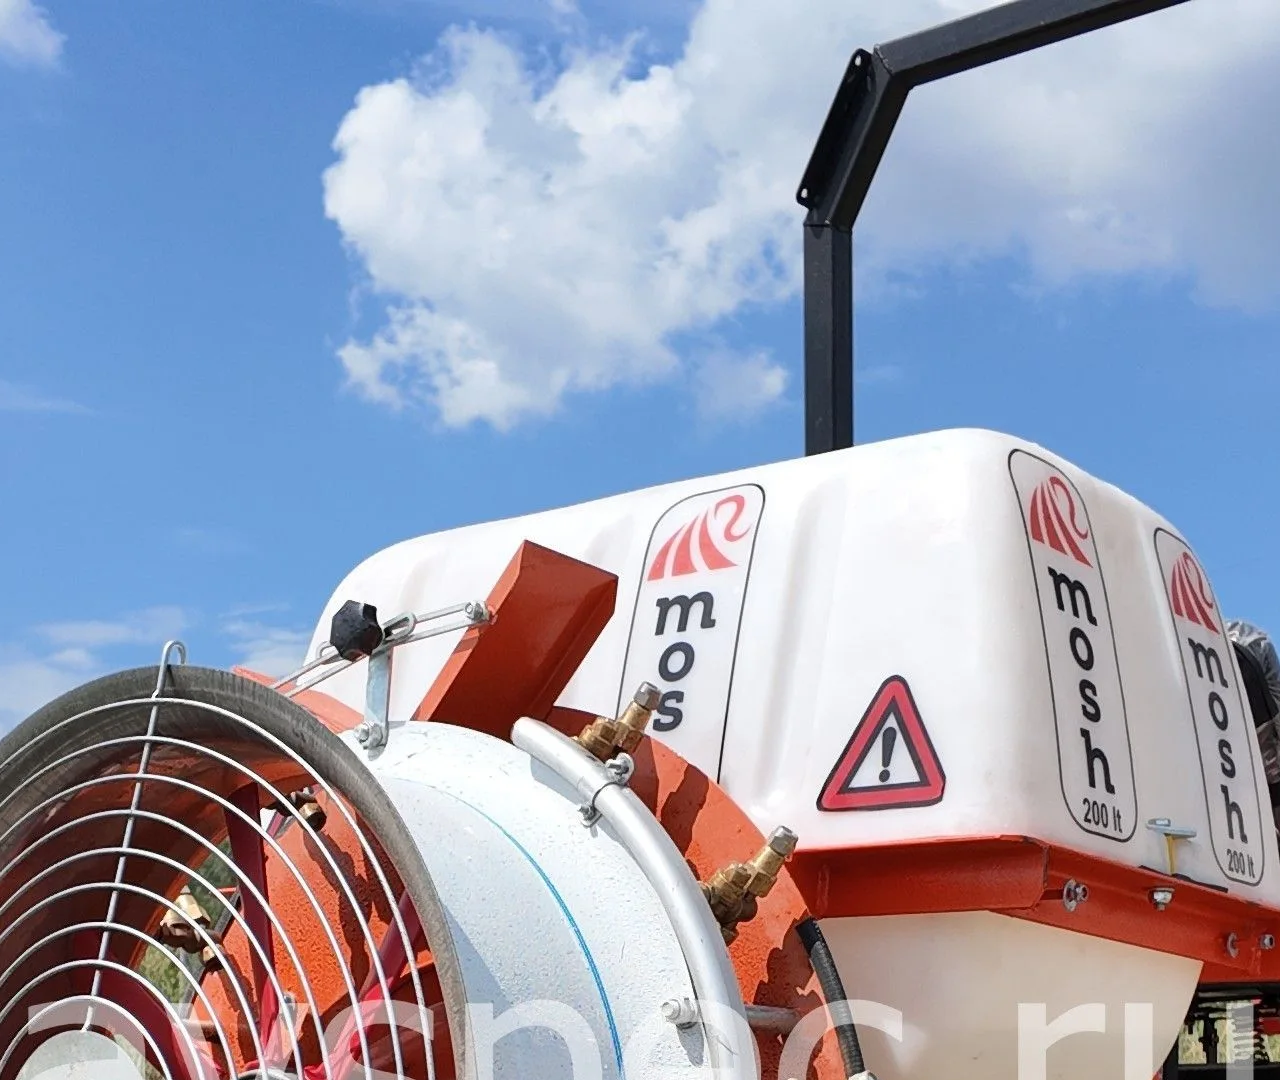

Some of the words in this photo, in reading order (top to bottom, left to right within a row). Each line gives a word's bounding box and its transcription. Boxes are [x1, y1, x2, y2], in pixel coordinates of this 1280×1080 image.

[653, 591, 716, 732] mos
[1047, 566, 1116, 795] mosh
[1187, 637, 1248, 845] mosh
[1082, 797, 1109, 828] 200
[1227, 847, 1246, 875] 200
